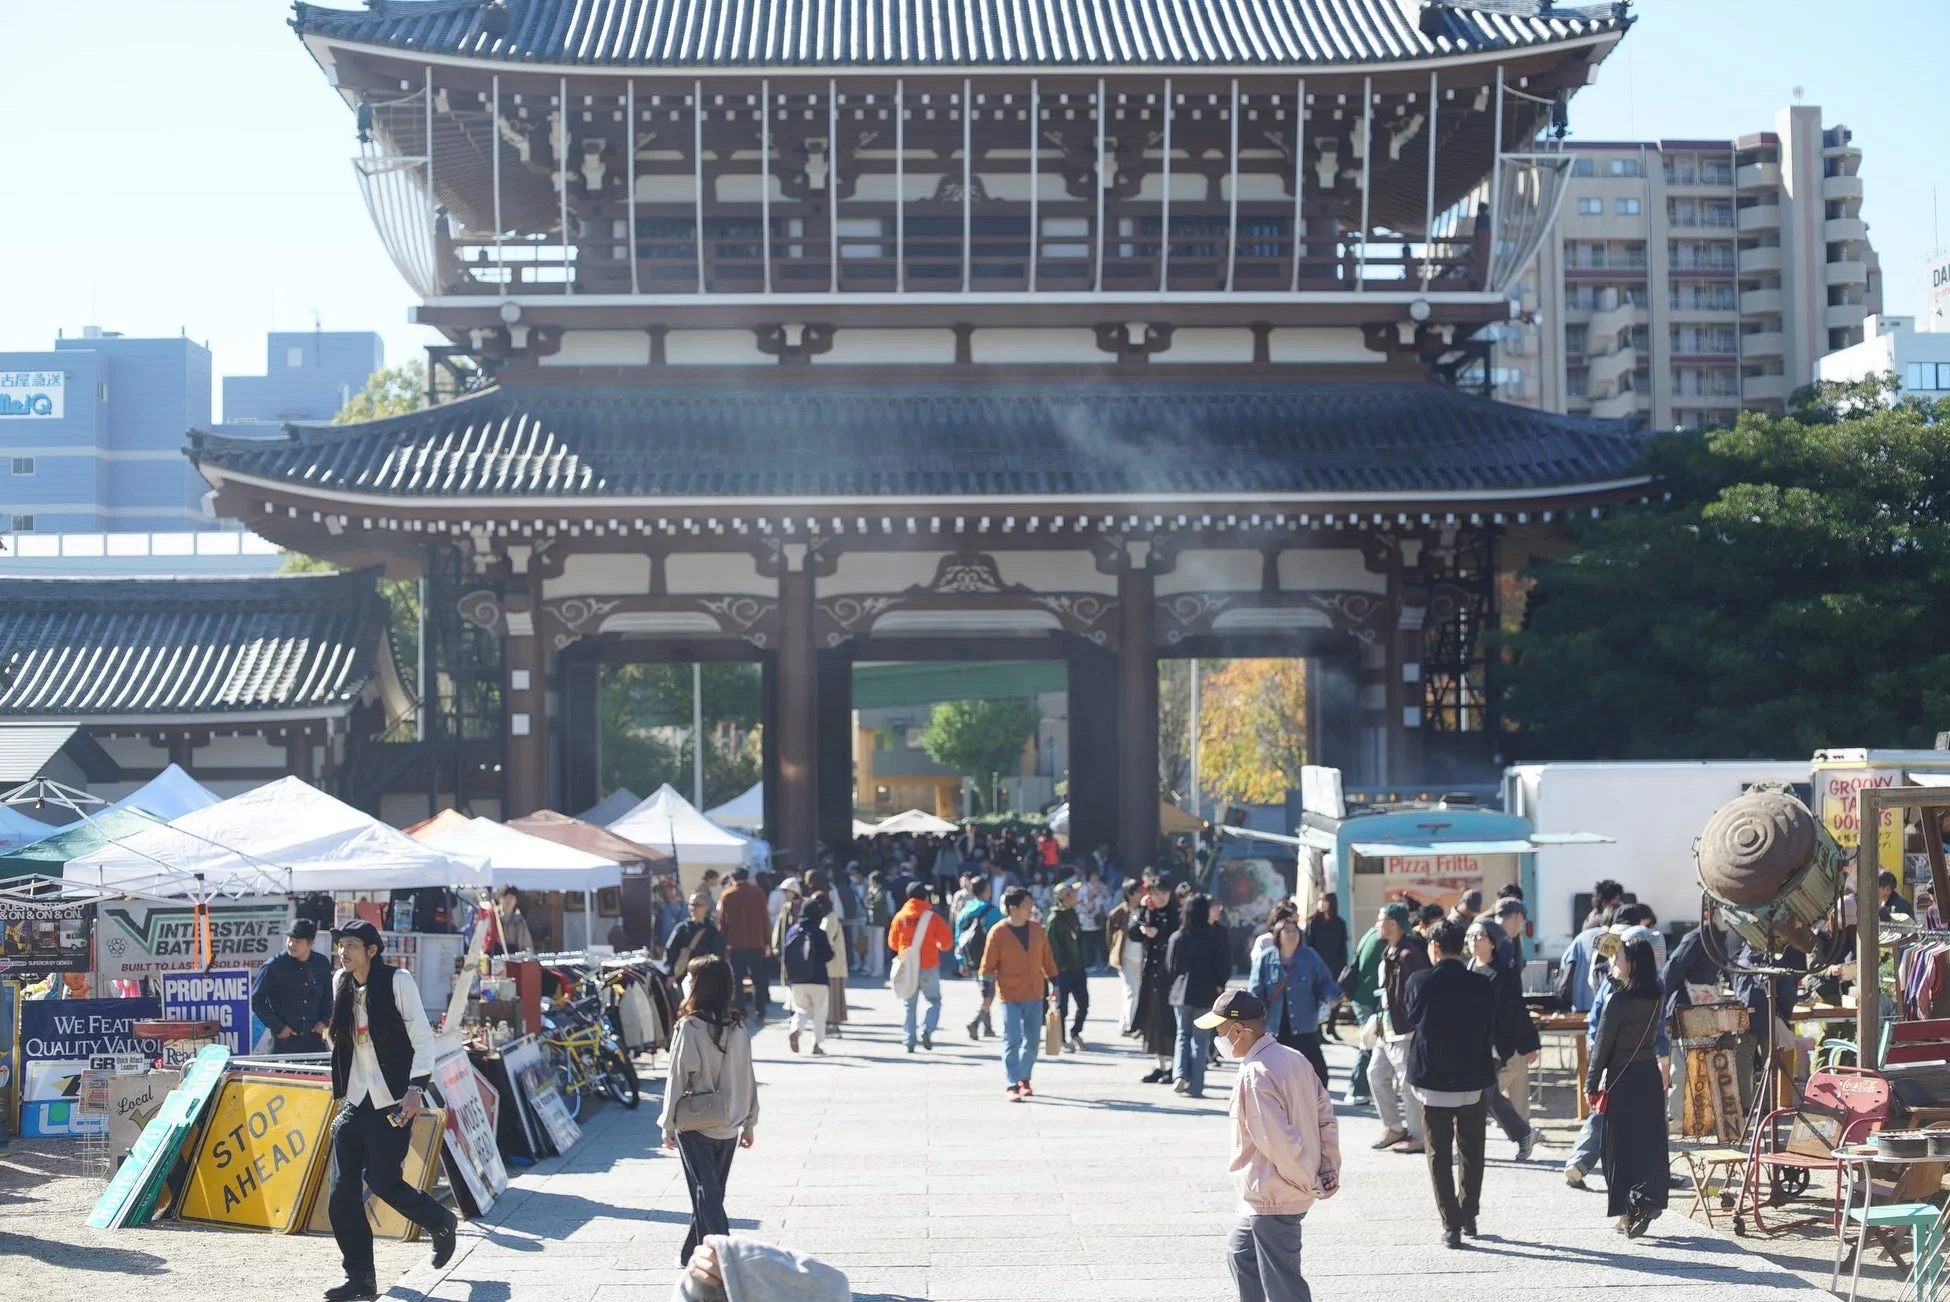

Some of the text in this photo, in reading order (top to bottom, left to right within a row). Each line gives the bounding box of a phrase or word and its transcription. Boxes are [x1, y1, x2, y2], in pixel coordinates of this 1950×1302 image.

[1389, 854, 1478, 873] Pizza Fritta
[9, 911, 25, 920] ON
[26, 911, 35, 920] &
[36, 911, 53, 920] ON
[54, 911, 63, 919] &
[121, 963, 151, 972] BUILT
[154, 962, 169, 971] TO
[171, 962, 197, 971] LAS
[165, 977, 248, 1002] PROPANE
[54, 1016, 85, 1034] WE
[26, 1037, 102, 1056] QUALITY
[117, 1085, 153, 1115] Local
[212, 1094, 285, 1169] STOP
[223, 1128, 306, 1214] AHEAD
